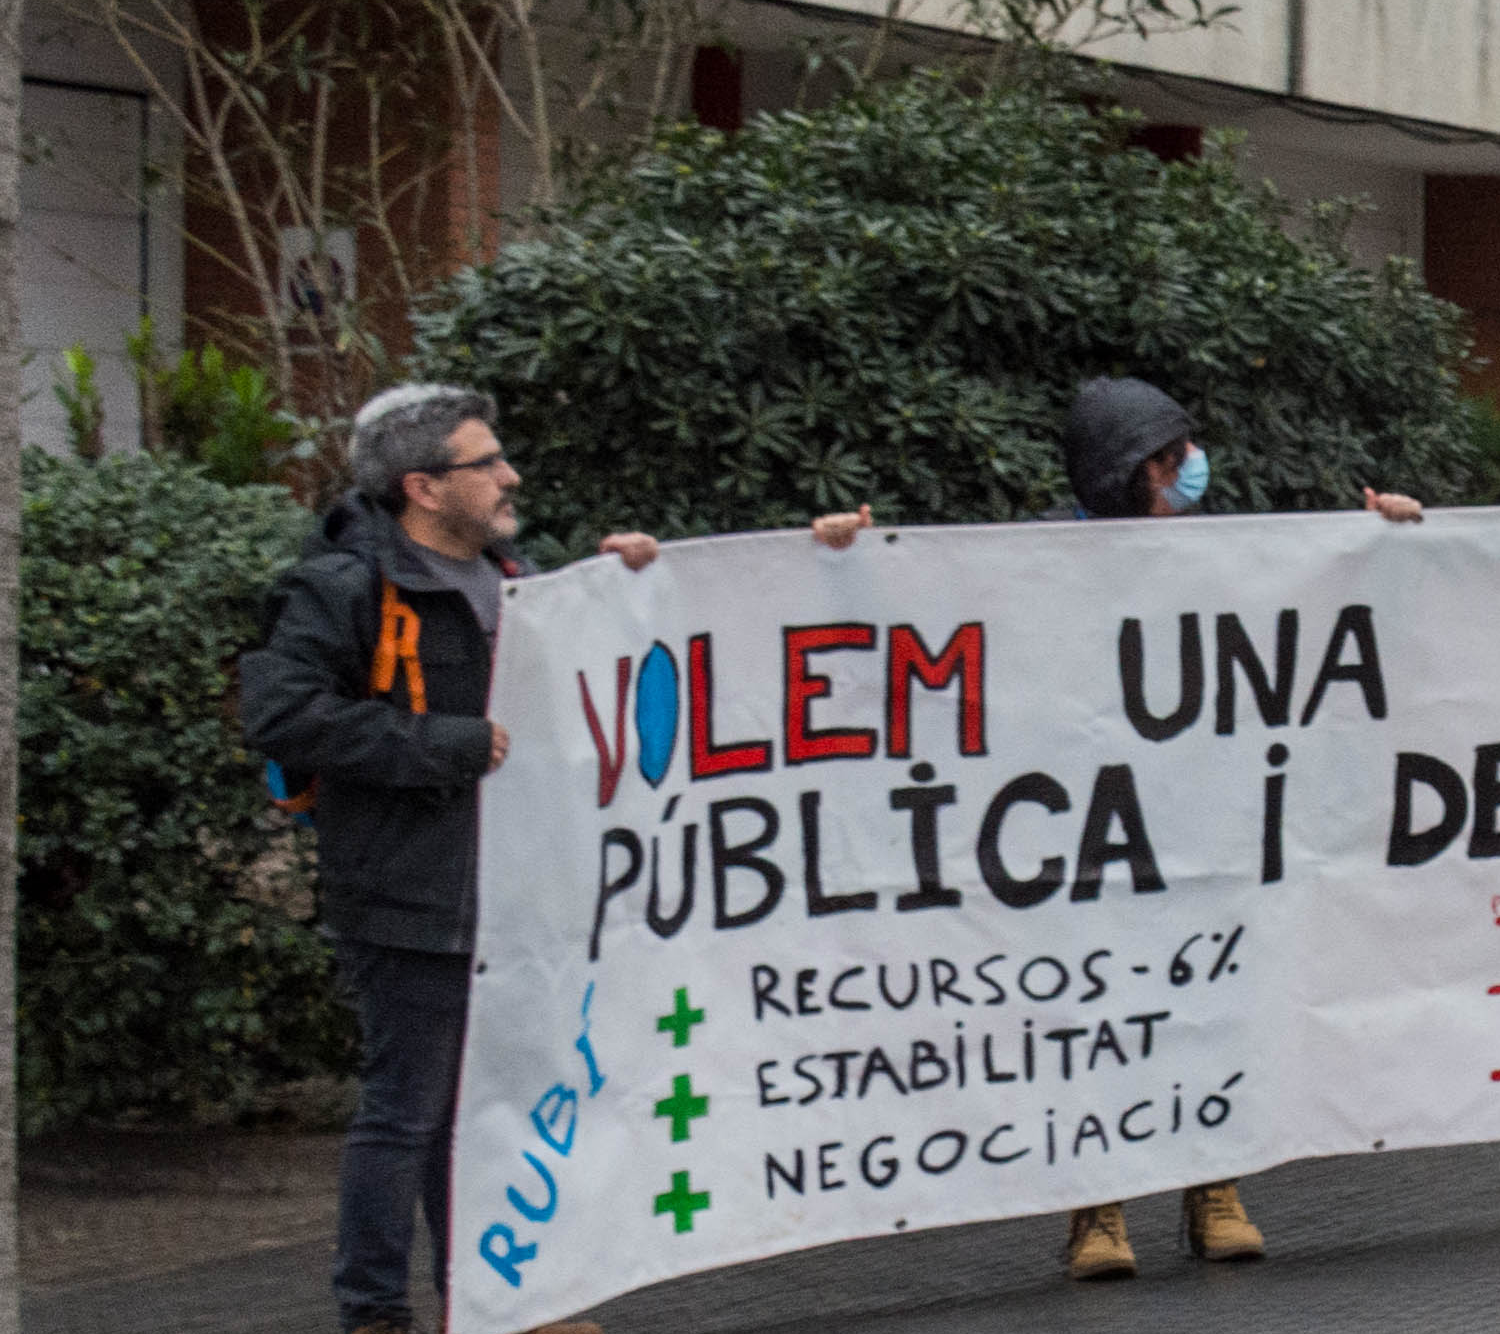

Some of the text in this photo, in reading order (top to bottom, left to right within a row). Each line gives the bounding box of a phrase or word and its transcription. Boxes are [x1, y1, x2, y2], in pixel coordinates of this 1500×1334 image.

[578, 621, 988, 808] VOLEM
[1117, 604, 1387, 742] UNA
[587, 761, 1168, 962] PÚBLICA
[752, 948, 1113, 1021] RECURSOS
